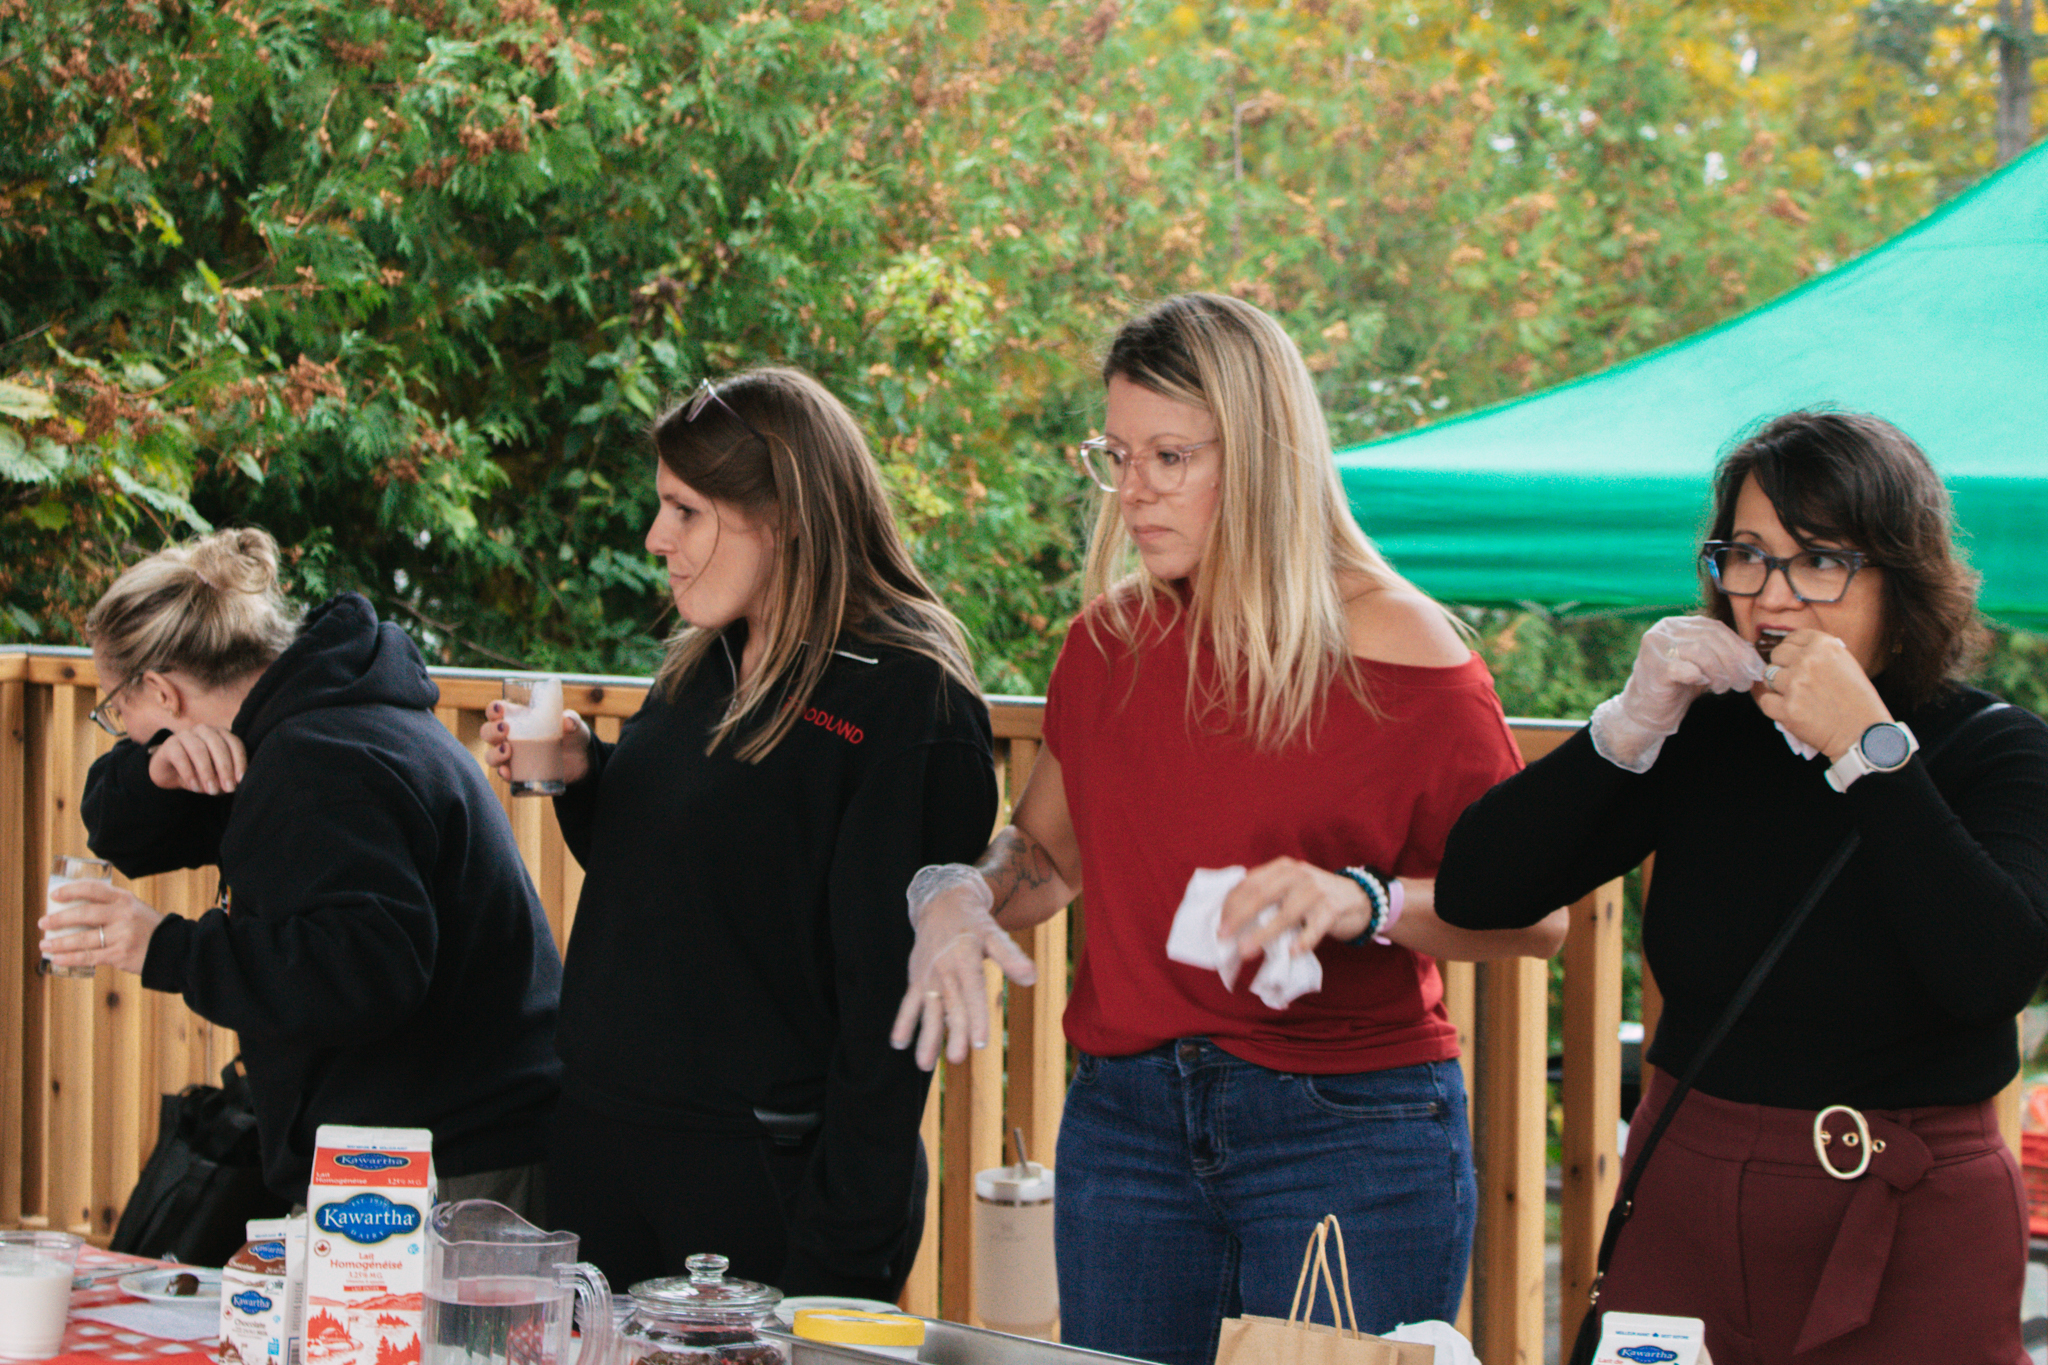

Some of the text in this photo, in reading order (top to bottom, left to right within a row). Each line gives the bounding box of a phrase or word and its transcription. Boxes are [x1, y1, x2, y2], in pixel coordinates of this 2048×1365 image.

[341, 1155, 404, 1166] Kawartha
[323, 1208, 413, 1228] Kawartha
[359, 1252, 375, 1260] Lait
[233, 1295, 271, 1309] Kawartha
[1620, 1348, 1674, 1360] Kawartha
